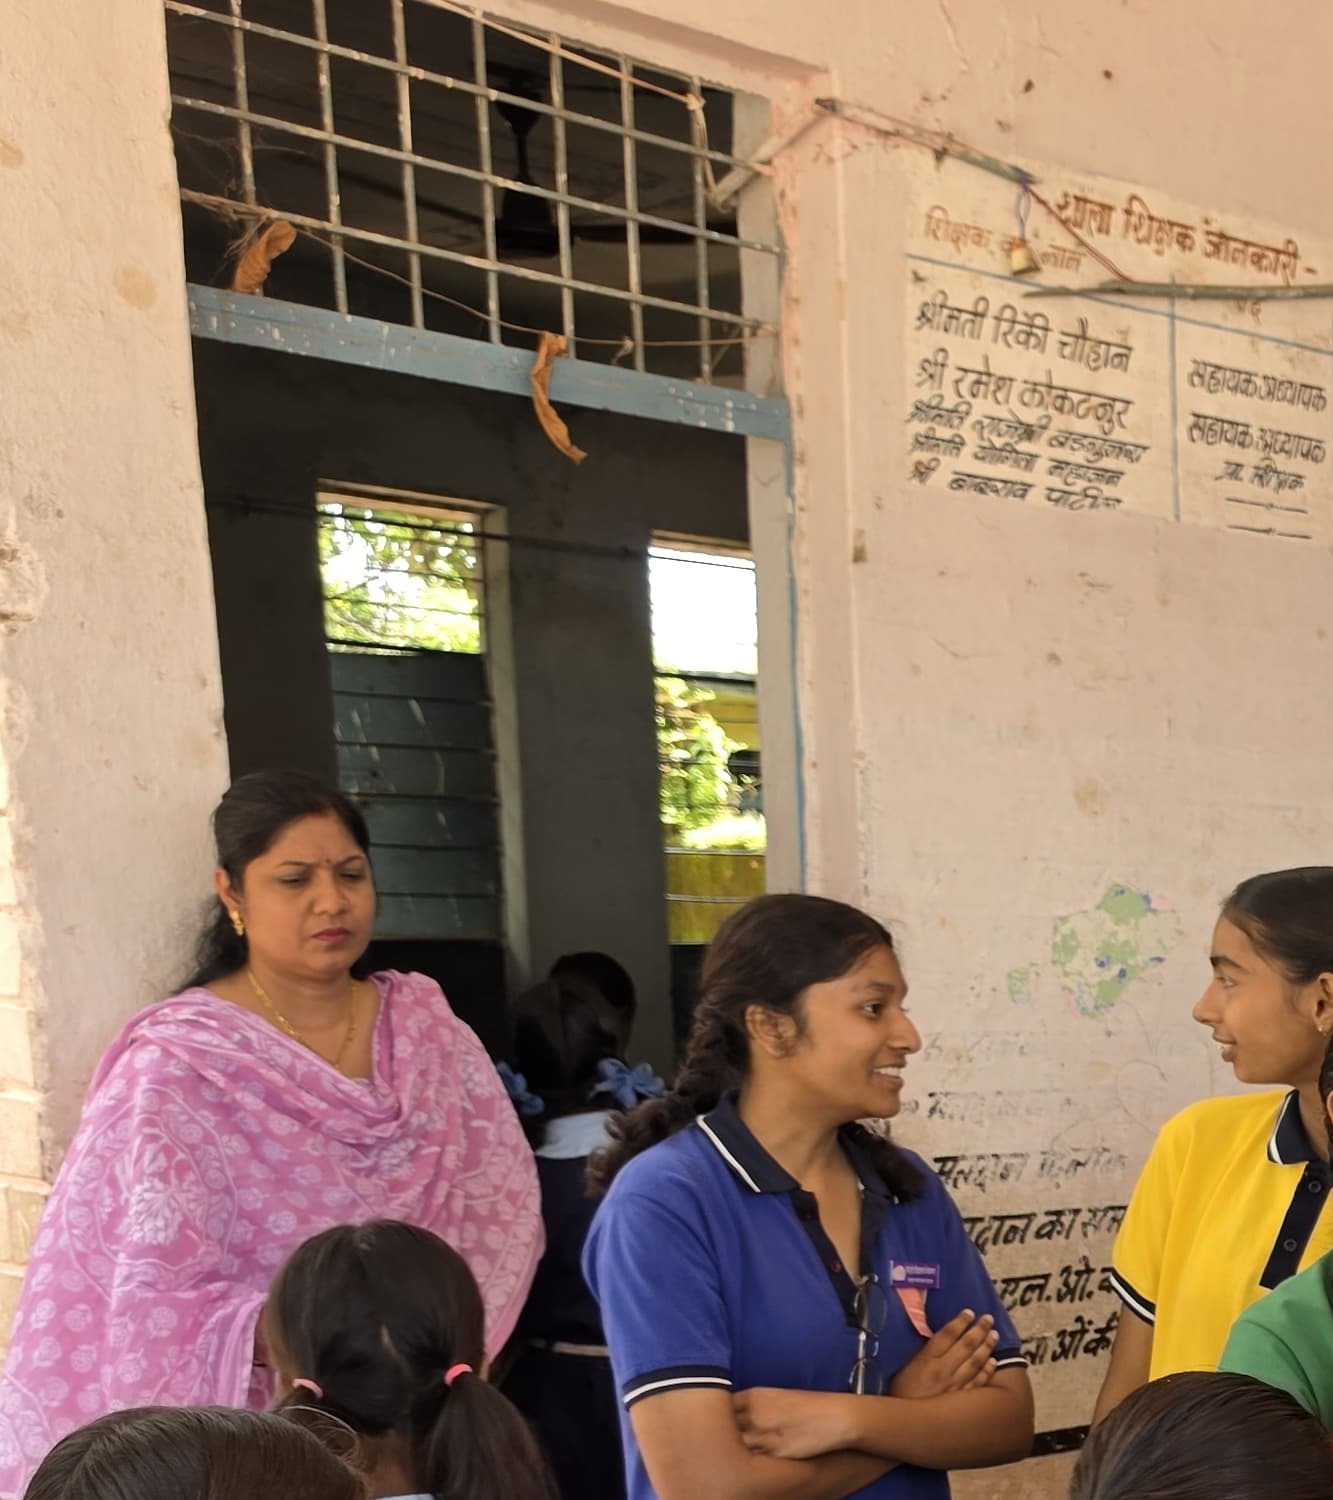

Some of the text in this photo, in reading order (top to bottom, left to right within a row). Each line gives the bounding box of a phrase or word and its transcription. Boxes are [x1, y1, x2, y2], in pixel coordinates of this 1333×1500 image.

[915, 290, 990, 341] श्रीमती
[1057, 316, 1135, 373] चौहान
[915, 348, 949, 391] श्री
[952, 352, 1015, 406] रमेश
[1187, 358, 1258, 398] सहायक
[1187, 411, 1254, 449] सहायक
[1035, 1208, 1082, 1241] का
